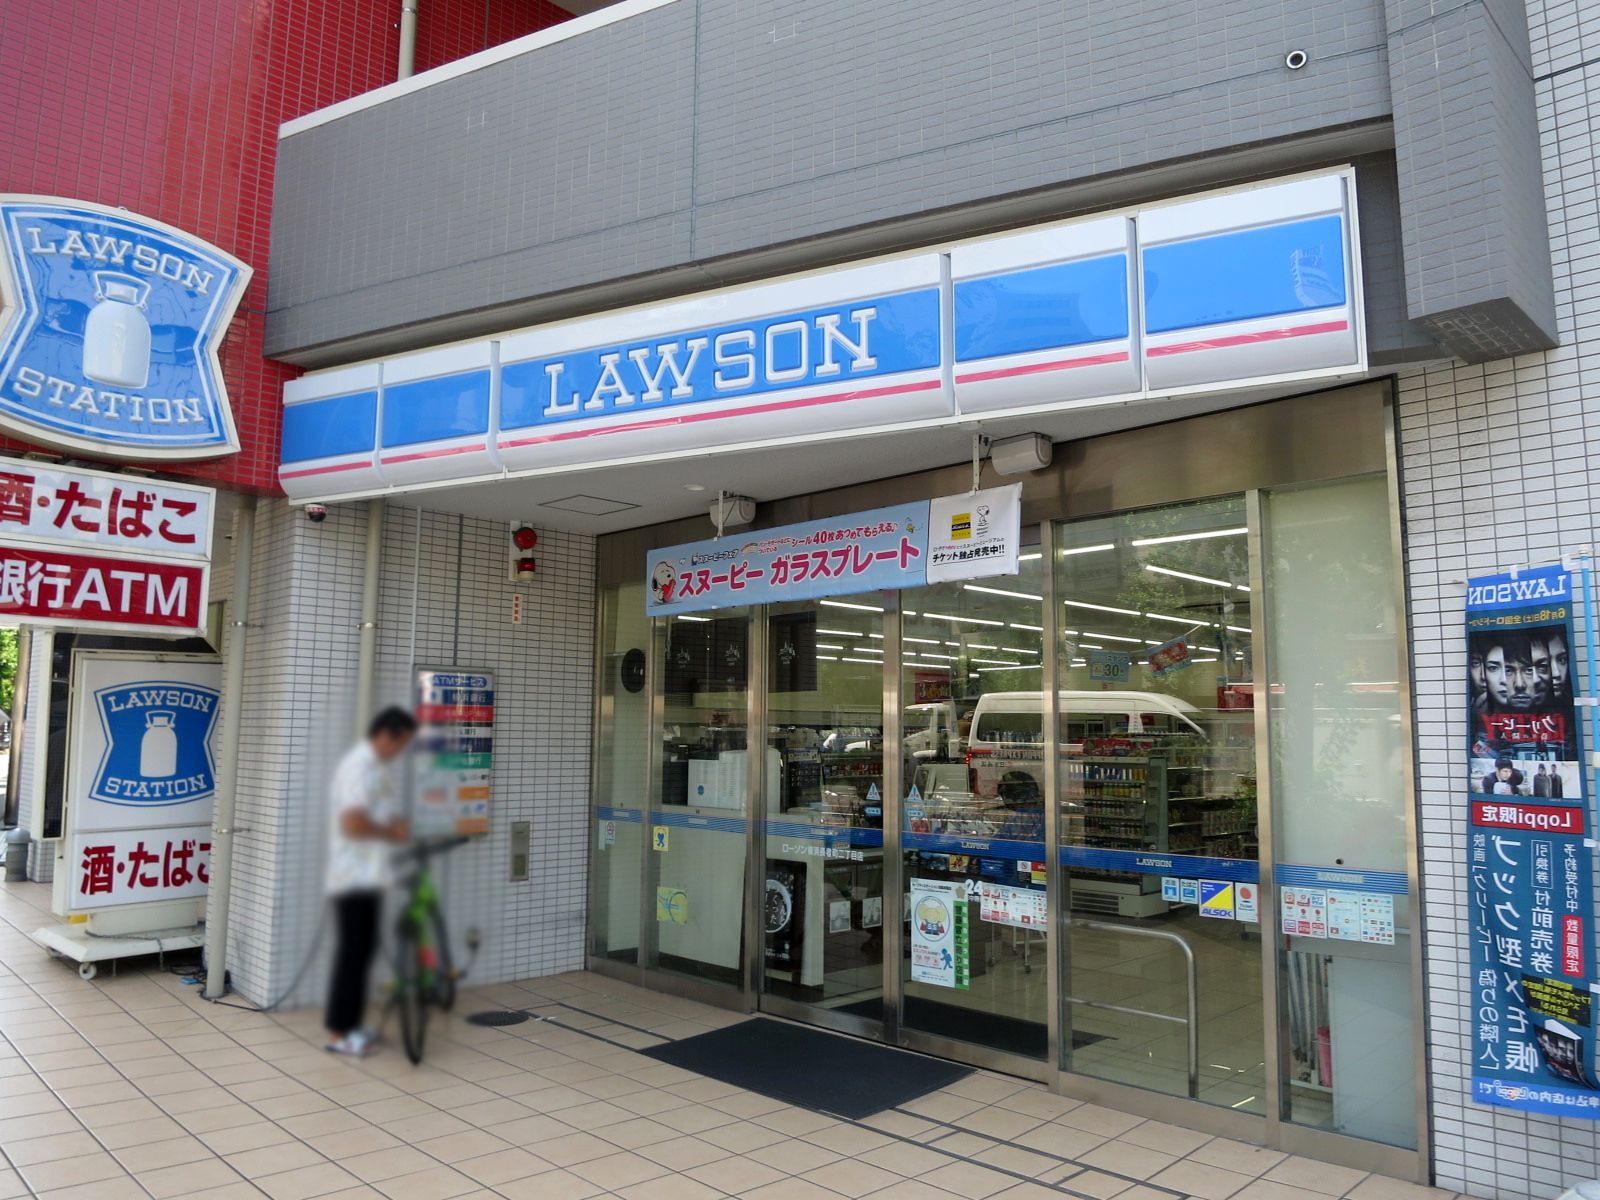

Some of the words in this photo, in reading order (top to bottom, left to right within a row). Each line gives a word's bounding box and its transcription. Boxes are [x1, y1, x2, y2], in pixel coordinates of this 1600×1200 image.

[28, 227, 214, 295] LAWSON
[543, 306, 877, 417] LAWSON
[13, 366, 205, 424] STATION
[678, 561, 764, 599] スヌーピー
[770, 536, 922, 586] ガラスプレート
[108, 690, 212, 713] LAWSON
[105, 774, 207, 798] STATION
[1135, 857, 1173, 868] LAWSON
[1201, 908, 1232, 918] ALSOK
